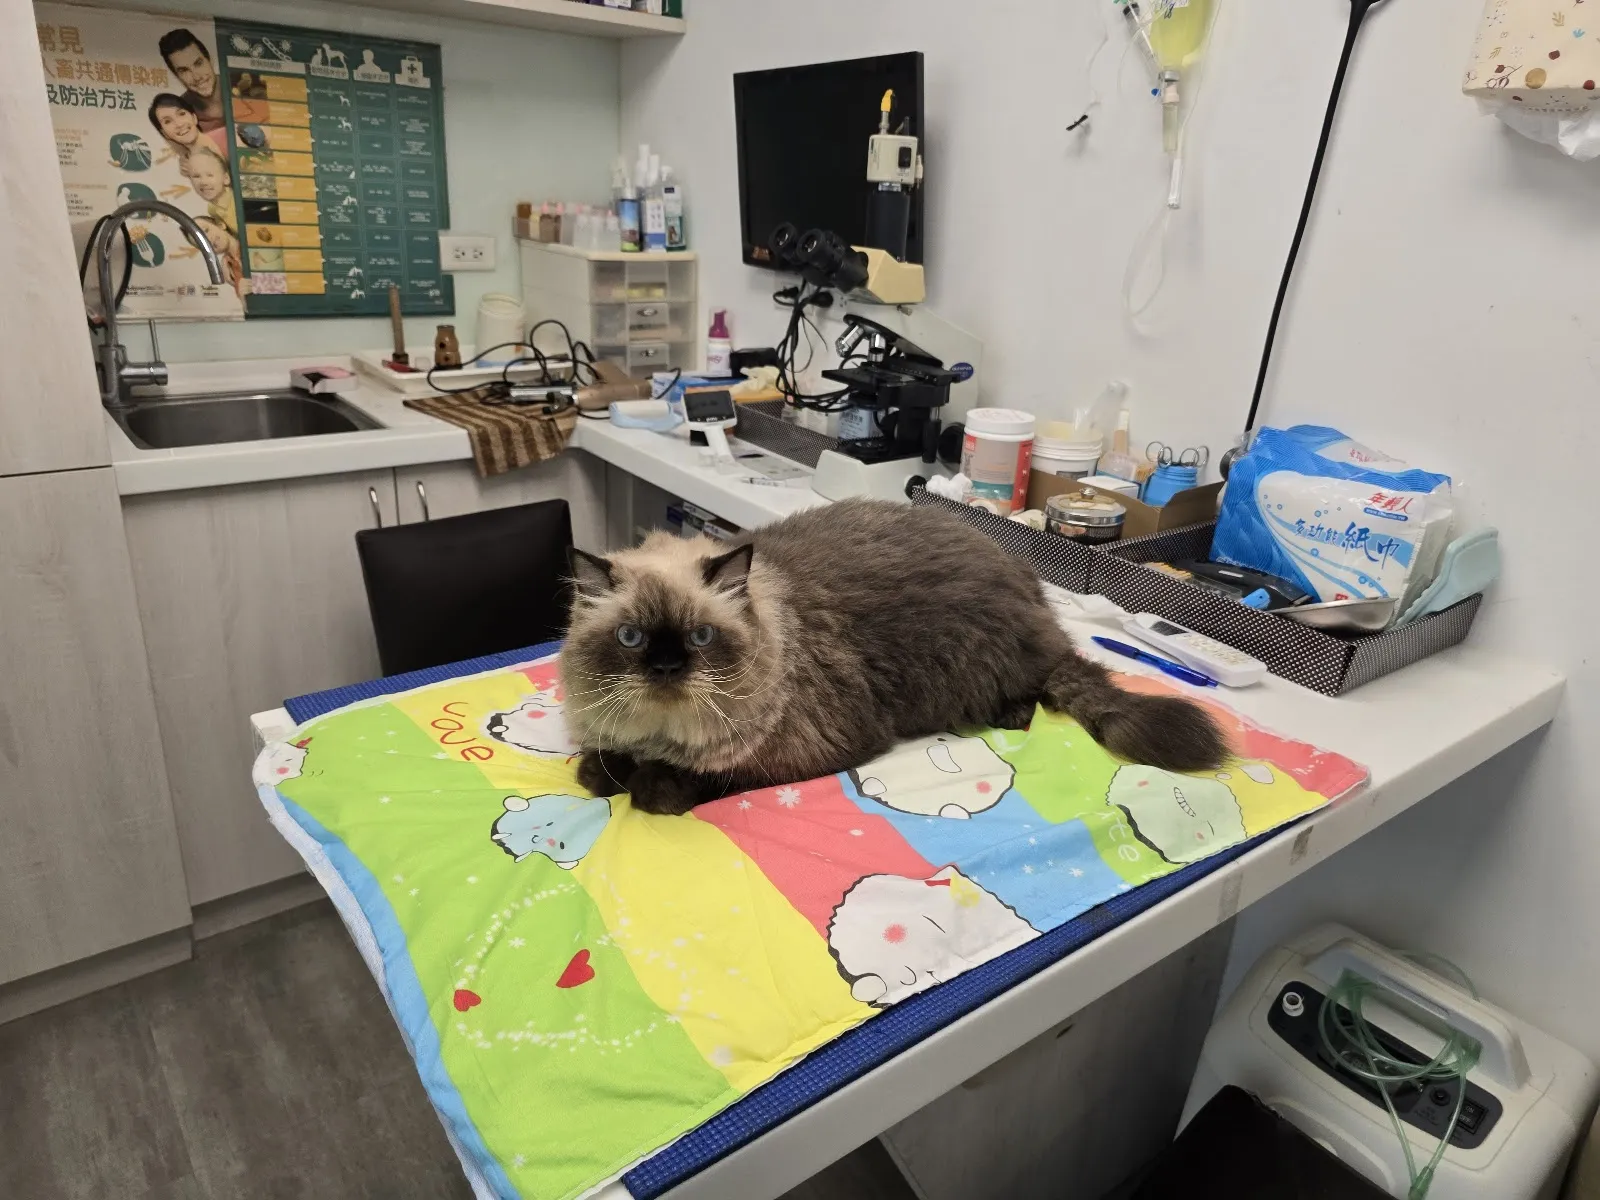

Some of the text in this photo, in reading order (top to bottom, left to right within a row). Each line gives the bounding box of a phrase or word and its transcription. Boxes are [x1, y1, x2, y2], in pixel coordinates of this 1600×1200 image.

[37, 23, 84, 54] 常見
[46, 83, 137, 111] 及防治方法
[1295, 518, 1400, 570] 多功能紙巾
